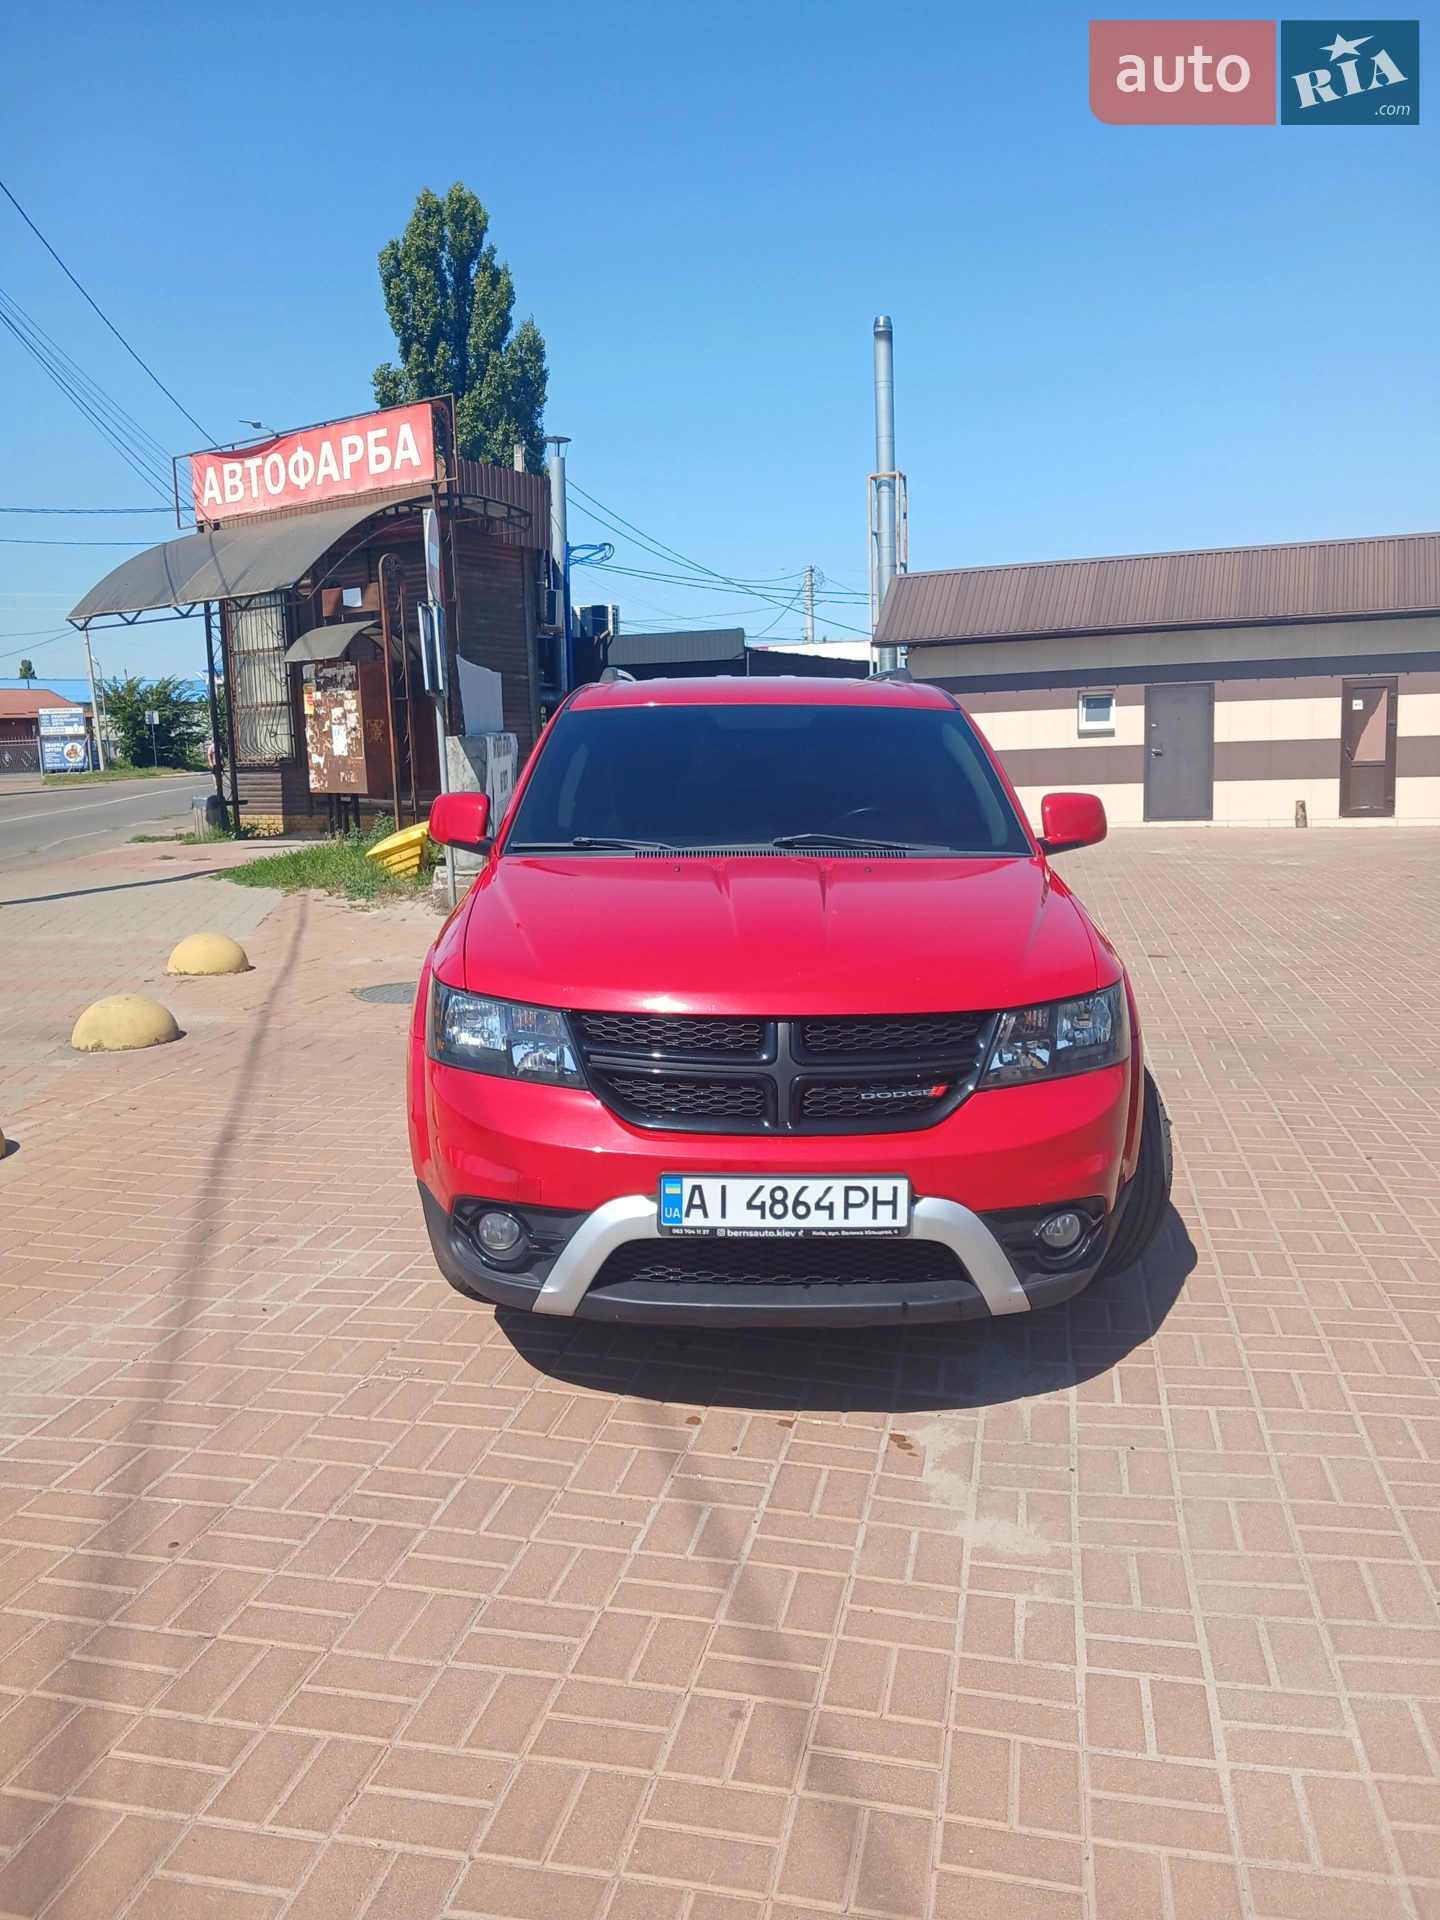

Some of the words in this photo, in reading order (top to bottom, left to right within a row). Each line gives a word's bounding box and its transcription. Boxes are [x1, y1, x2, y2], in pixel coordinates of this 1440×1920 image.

[202, 423, 422, 508] АВТОФАРБА
[861, 1089, 933, 1099] DODGE
[665, 1209, 681, 1218] UA
[727, 1229, 796, 1237] bernsauto.kiev
